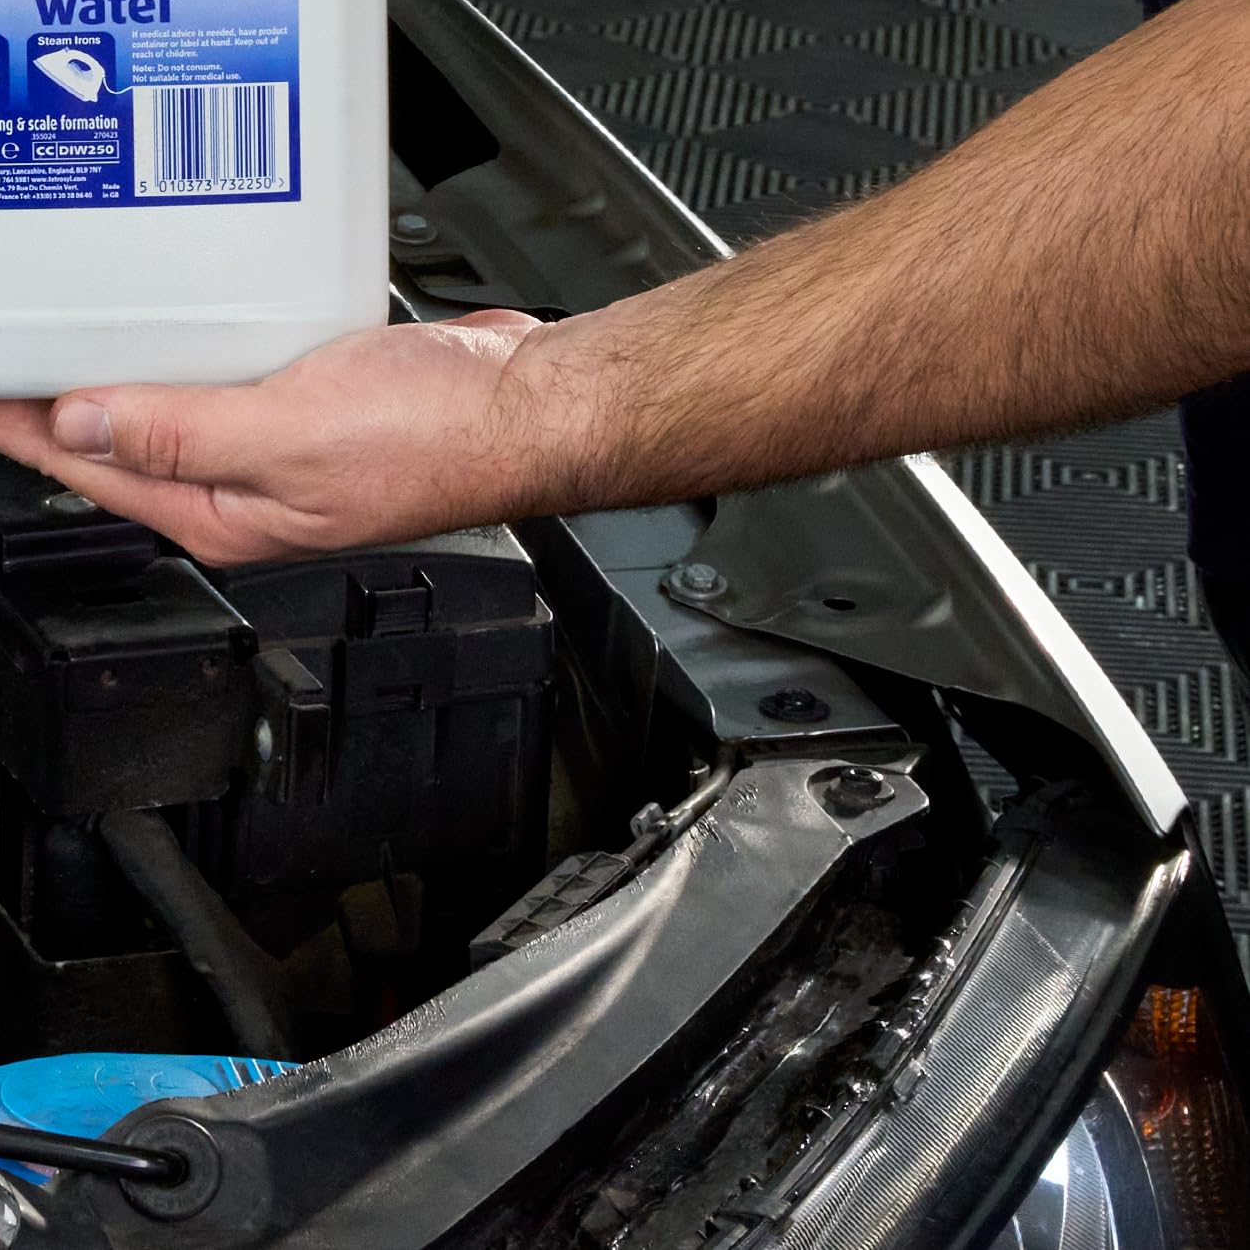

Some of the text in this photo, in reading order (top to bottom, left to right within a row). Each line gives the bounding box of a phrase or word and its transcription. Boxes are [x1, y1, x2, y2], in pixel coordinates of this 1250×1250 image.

[172, 30, 195, 38] advice
[206, 29, 236, 37] needed,
[258, 27, 287, 38] product
[38, 36, 101, 45] Steam Irons
[201, 39, 209, 47] at
[235, 38, 253, 47] Keep
[149, 74, 180, 82] suitable
[182, 73, 193, 81] for
[195, 72, 224, 80] medical
[17, 118, 25, 131] &
[29, 115, 57, 131] scale
[60, 115, 118, 129] formation
[36, 146, 54, 155] CC
[59, 145, 114, 155] DIW250
[140, 181, 147, 193] 5
[159, 180, 211, 192] 010373
[220, 177, 271, 190] 732250
